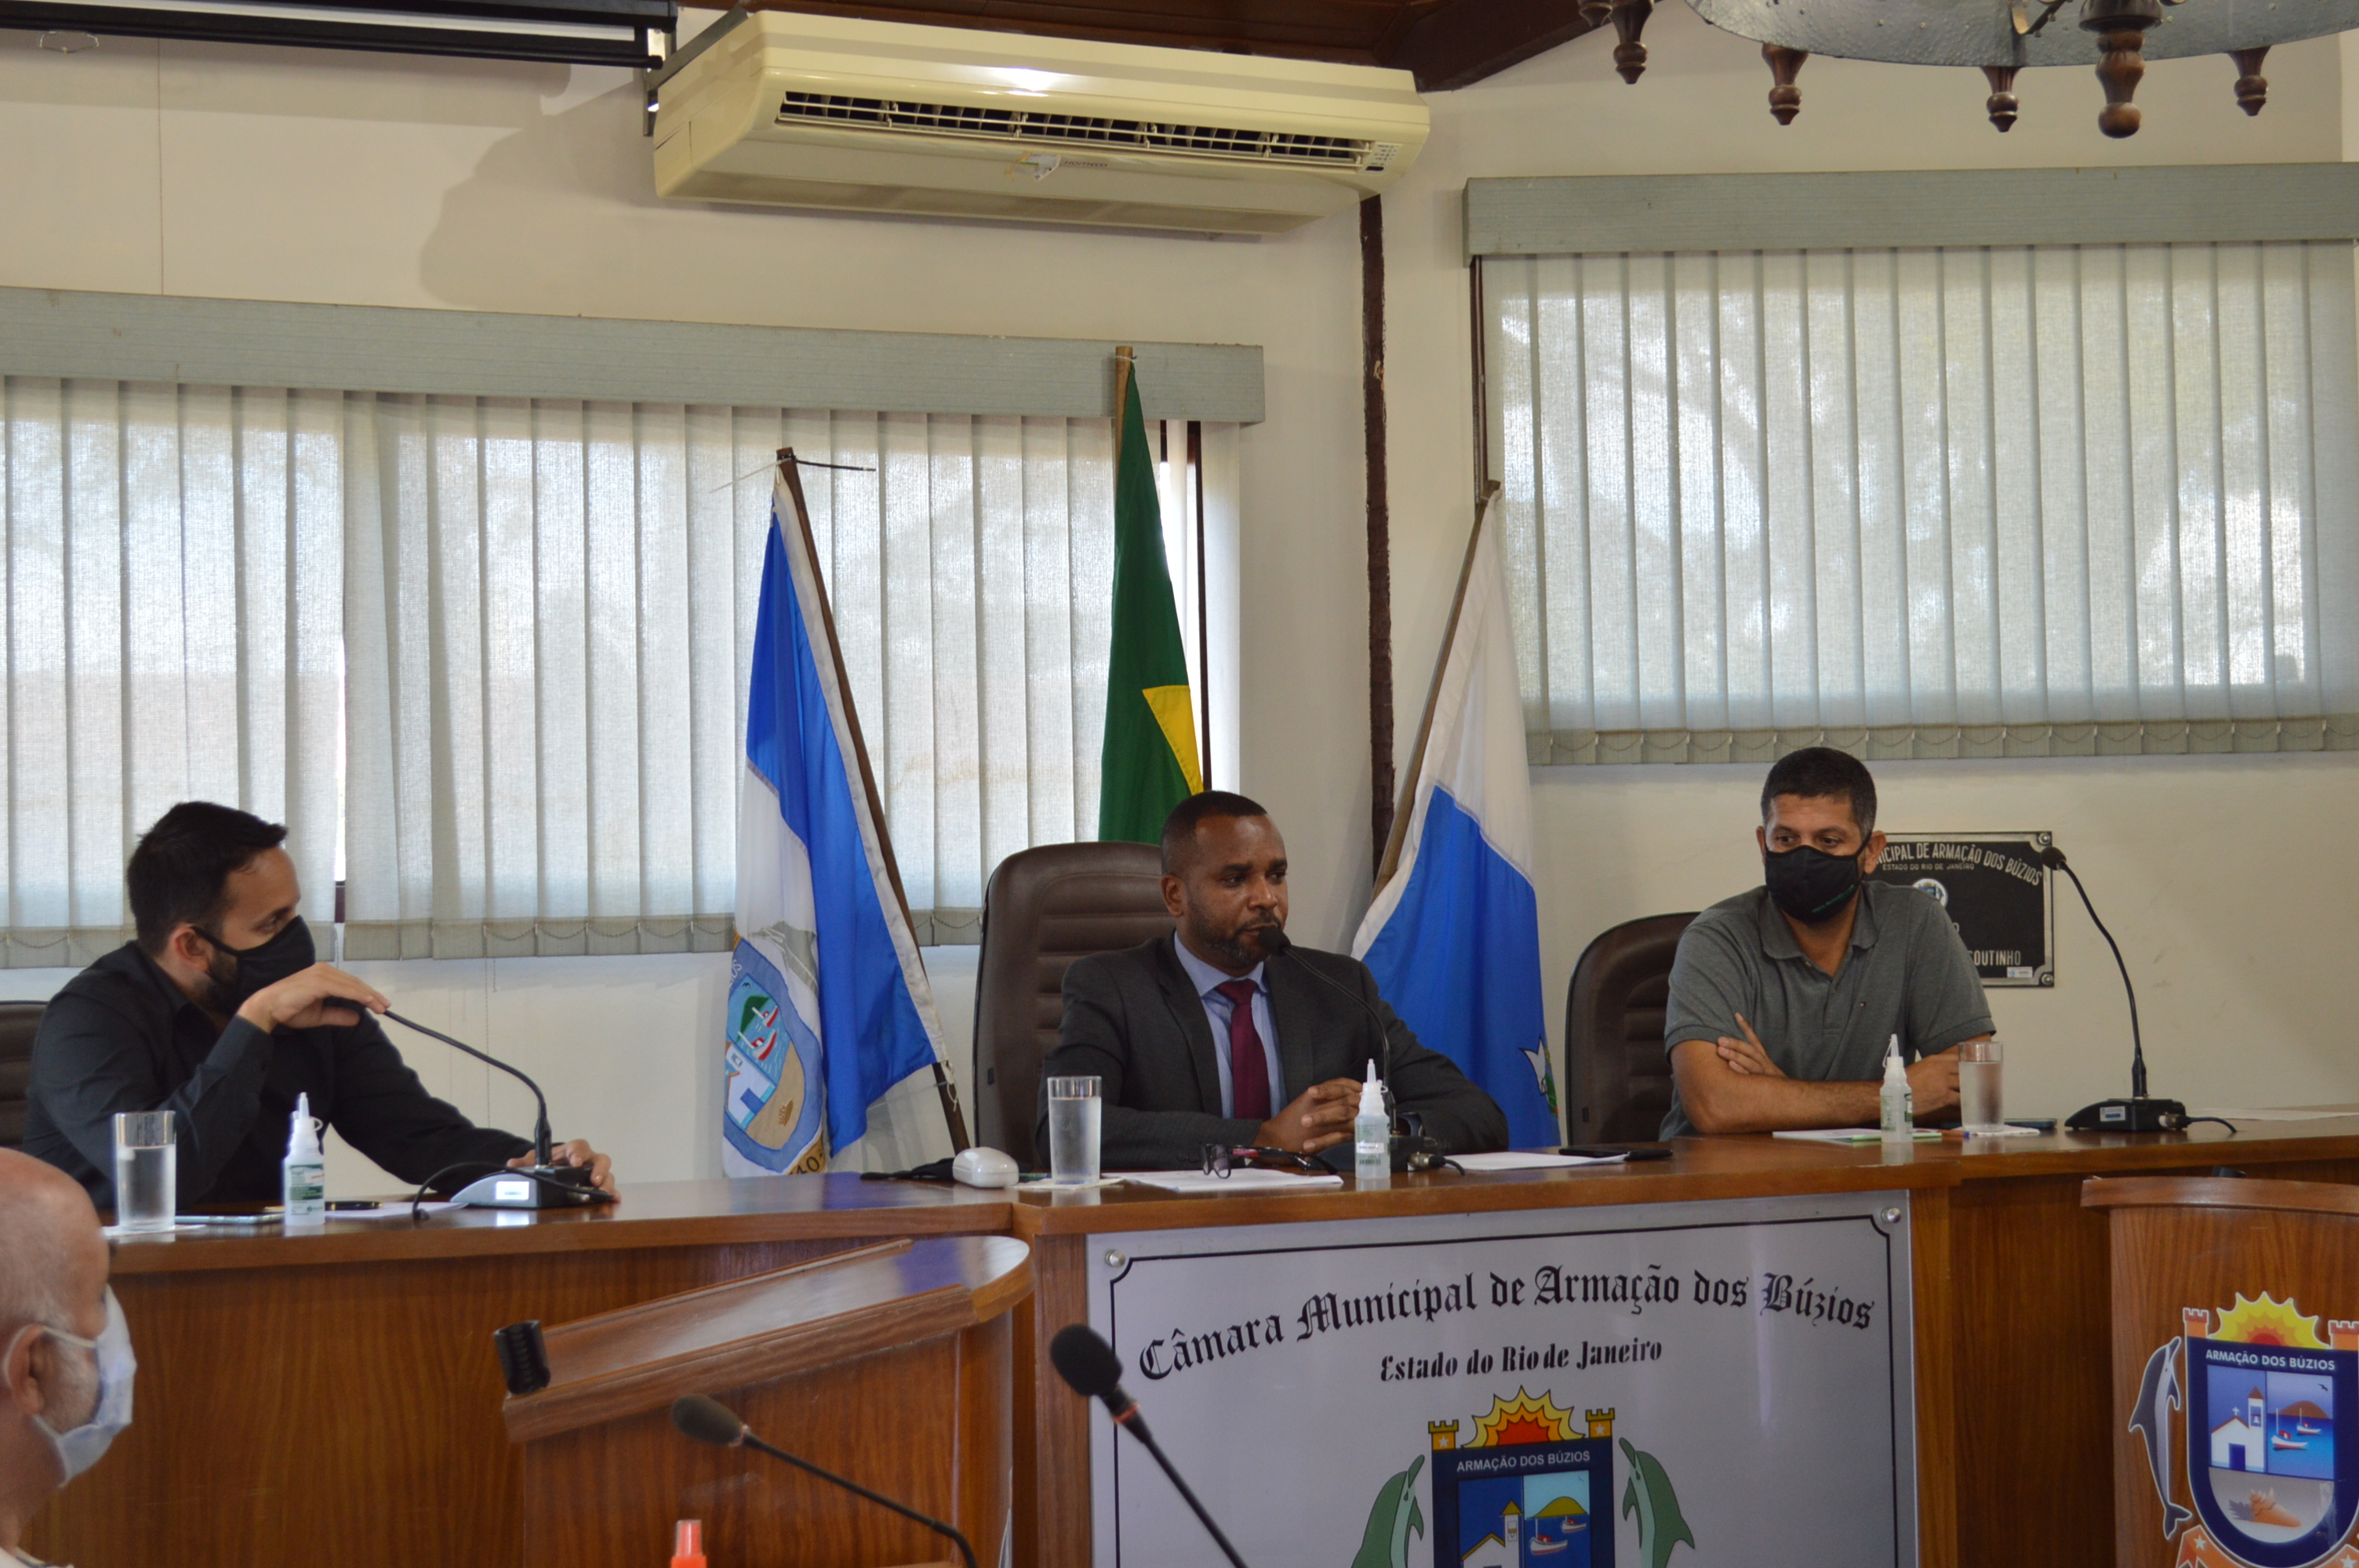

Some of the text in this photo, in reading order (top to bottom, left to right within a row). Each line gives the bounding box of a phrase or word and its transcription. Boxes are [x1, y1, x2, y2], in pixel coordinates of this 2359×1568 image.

[1917, 843, 1929, 858] DE
[1932, 843, 1983, 864] ARMAÇÃO
[1983, 851, 2005, 870] DOS
[2005, 857, 2042, 886] BÚZIOS
[1139, 1264, 1875, 1381] Câmara Municipal de Armação dos Búzios
[1380, 1337, 1663, 1382] Estado do Rio de Janeiro
[2205, 1349, 2335, 1371] ARMAÇÃO DOS BÚZIOS
[1456, 1450, 1590, 1472] ARMAÇÃO DOS BÚZIOS
